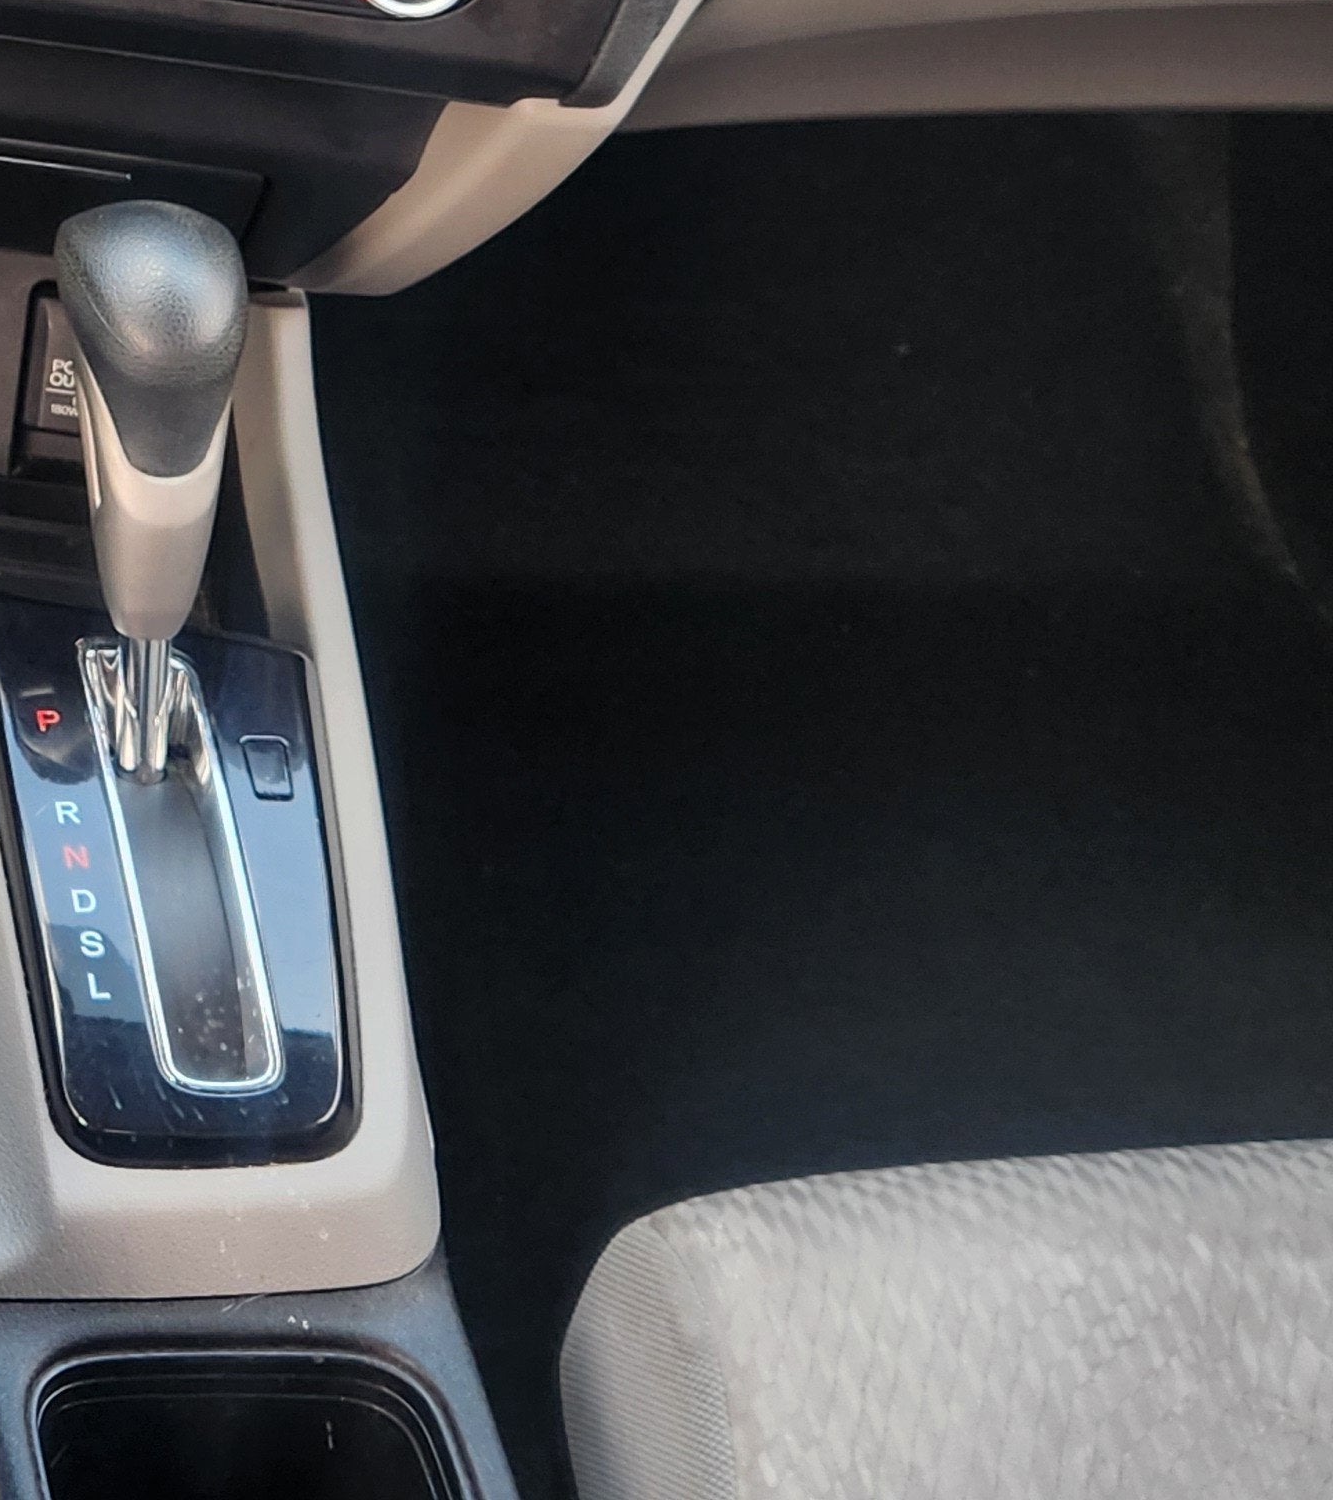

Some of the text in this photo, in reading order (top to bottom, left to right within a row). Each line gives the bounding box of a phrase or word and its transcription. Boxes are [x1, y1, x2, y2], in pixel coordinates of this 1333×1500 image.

[36, 710, 60, 732] P
[56, 801, 81, 824] R
[62, 846, 90, 869] N
[72, 889, 96, 913] D
[80, 931, 105, 957] S
[87, 973, 111, 1000] L
